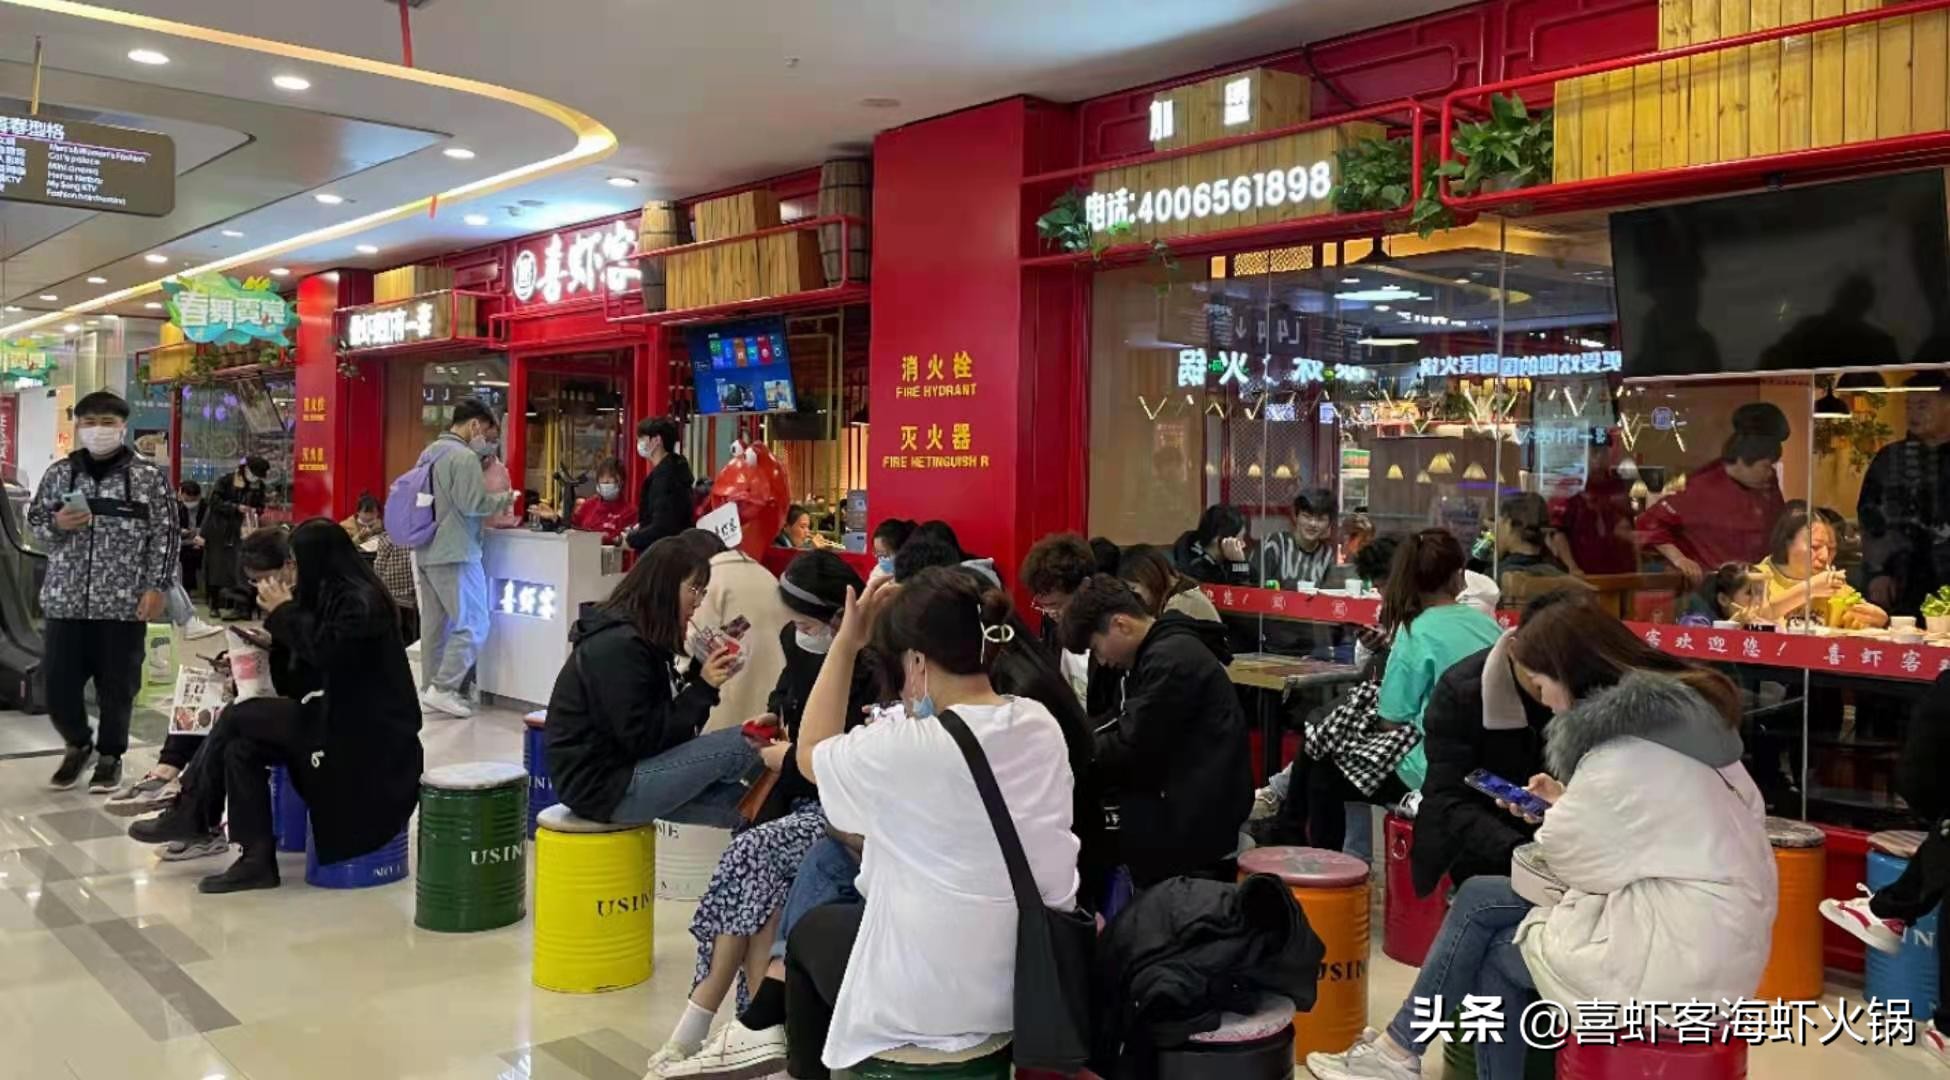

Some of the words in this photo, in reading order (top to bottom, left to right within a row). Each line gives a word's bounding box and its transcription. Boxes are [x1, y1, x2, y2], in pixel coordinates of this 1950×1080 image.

[1149, 77, 1250, 142] 加盟
[902, 350, 972, 382] 消火栓
[895, 385, 921, 399] FIRE
[923, 383, 977, 398] HYDRANT
[900, 423, 971, 450] 灭火器
[882, 456, 907, 468] FIRE
